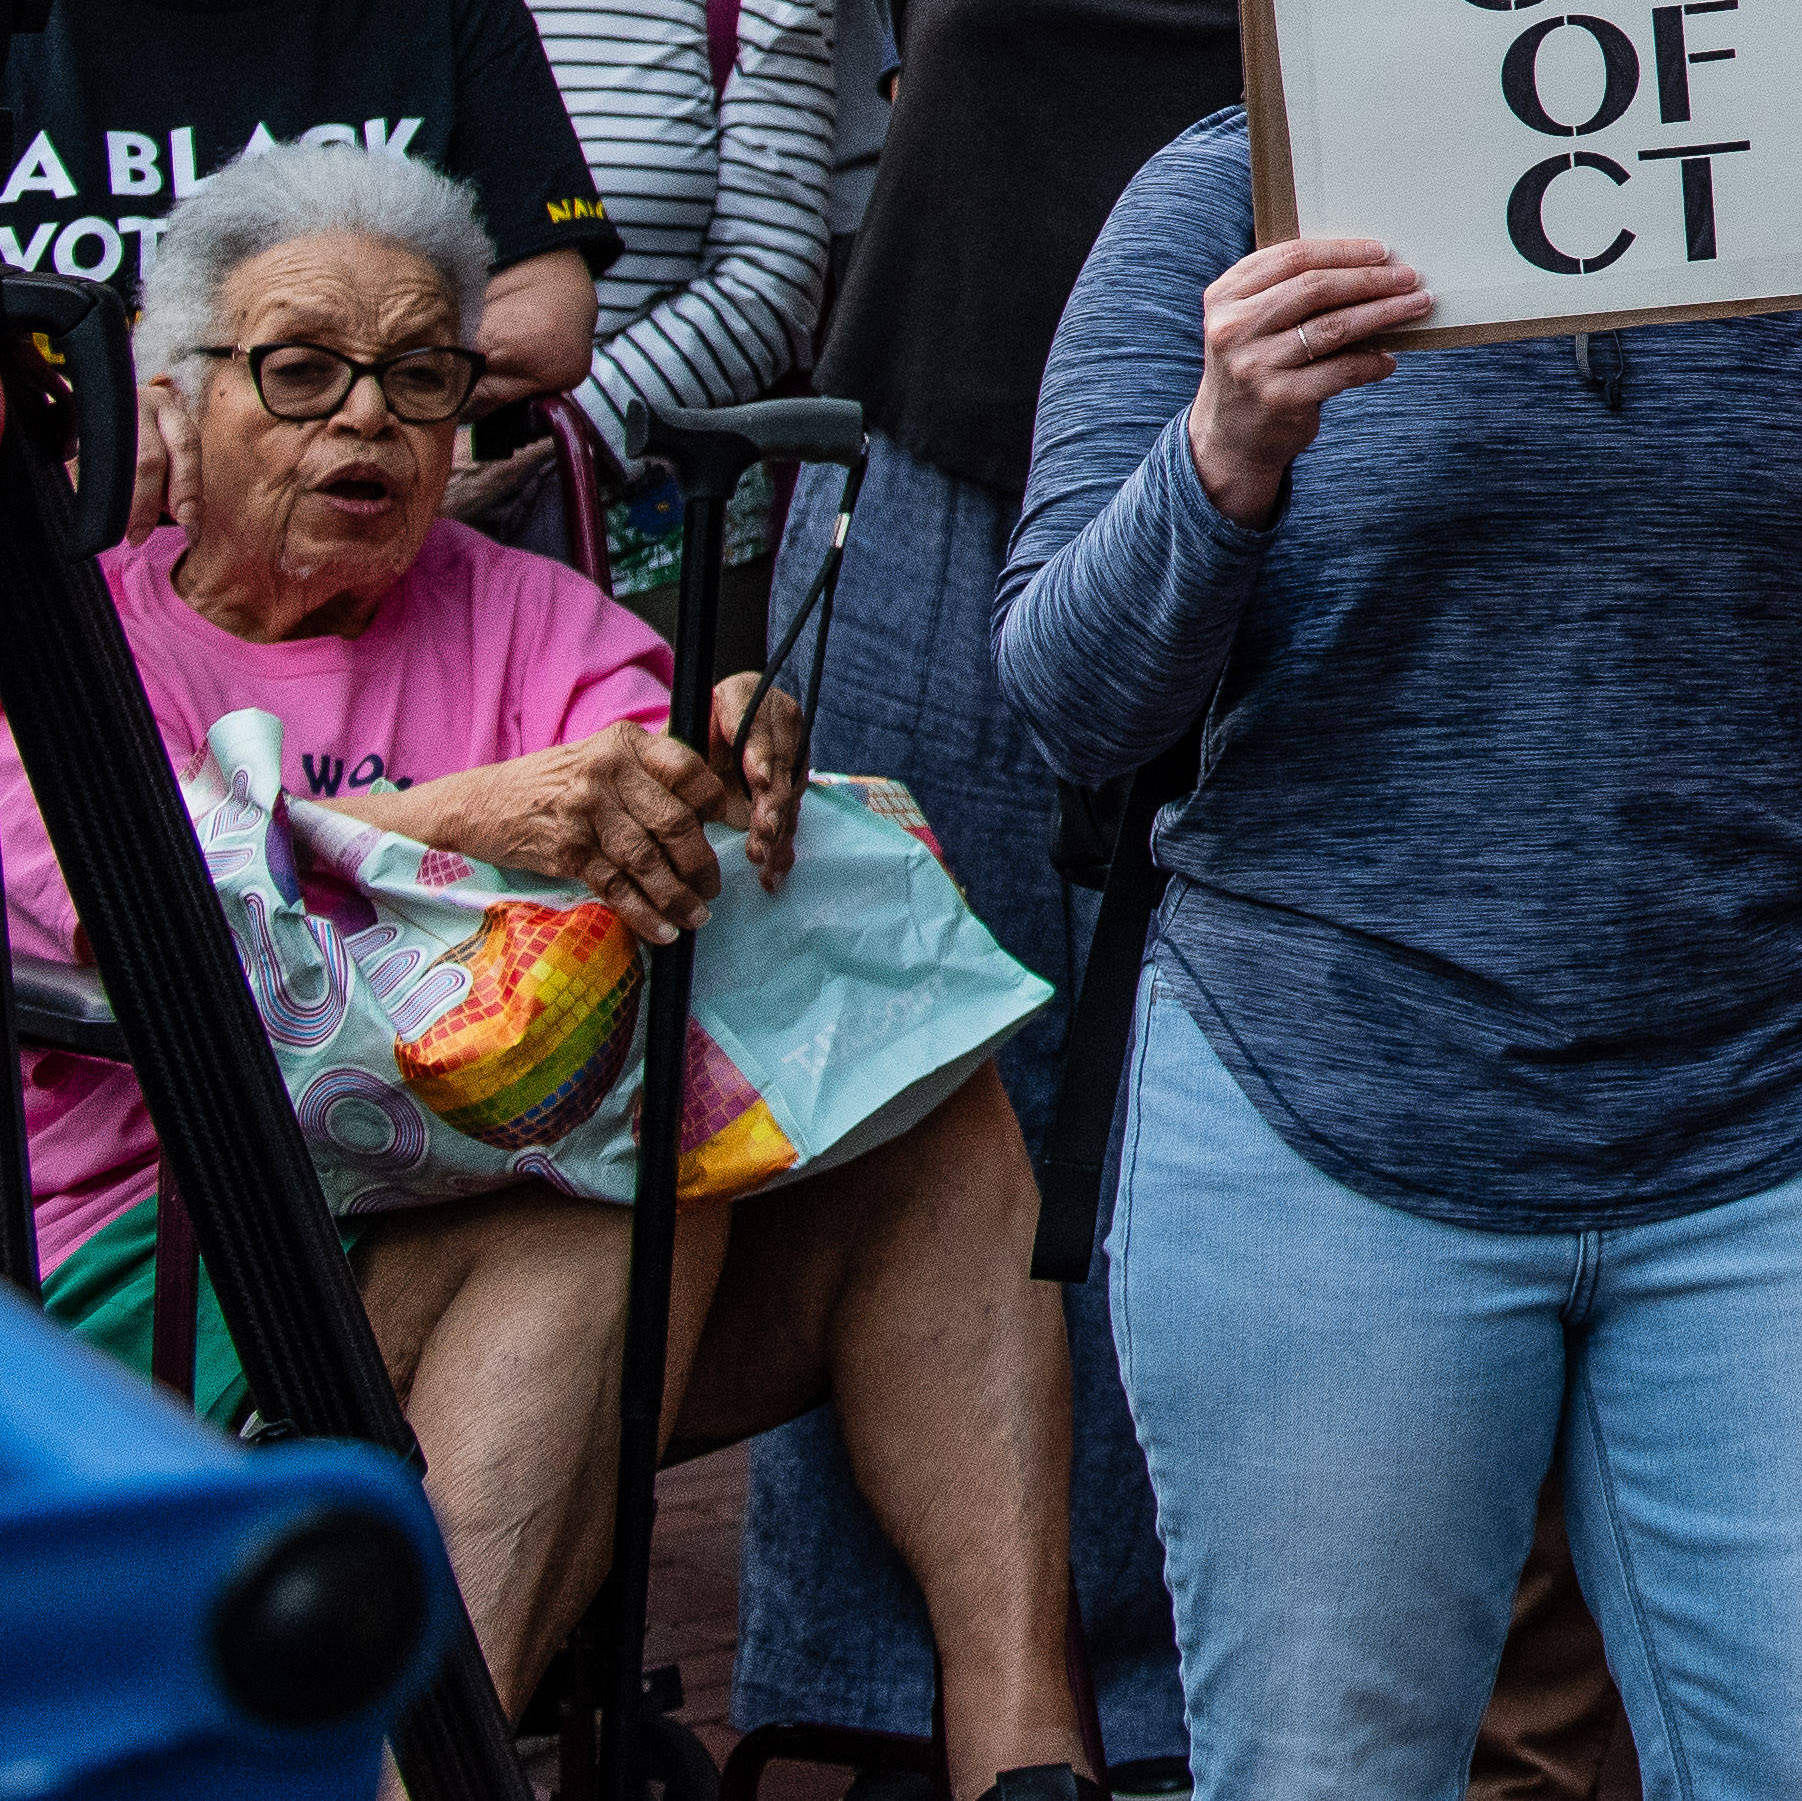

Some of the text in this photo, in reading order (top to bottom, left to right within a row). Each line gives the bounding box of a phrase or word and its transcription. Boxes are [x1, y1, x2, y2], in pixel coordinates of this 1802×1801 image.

[0, 116, 427, 201] A BLK
[0, 214, 170, 285] VOT
[1505, 139, 1752, 277] CT
